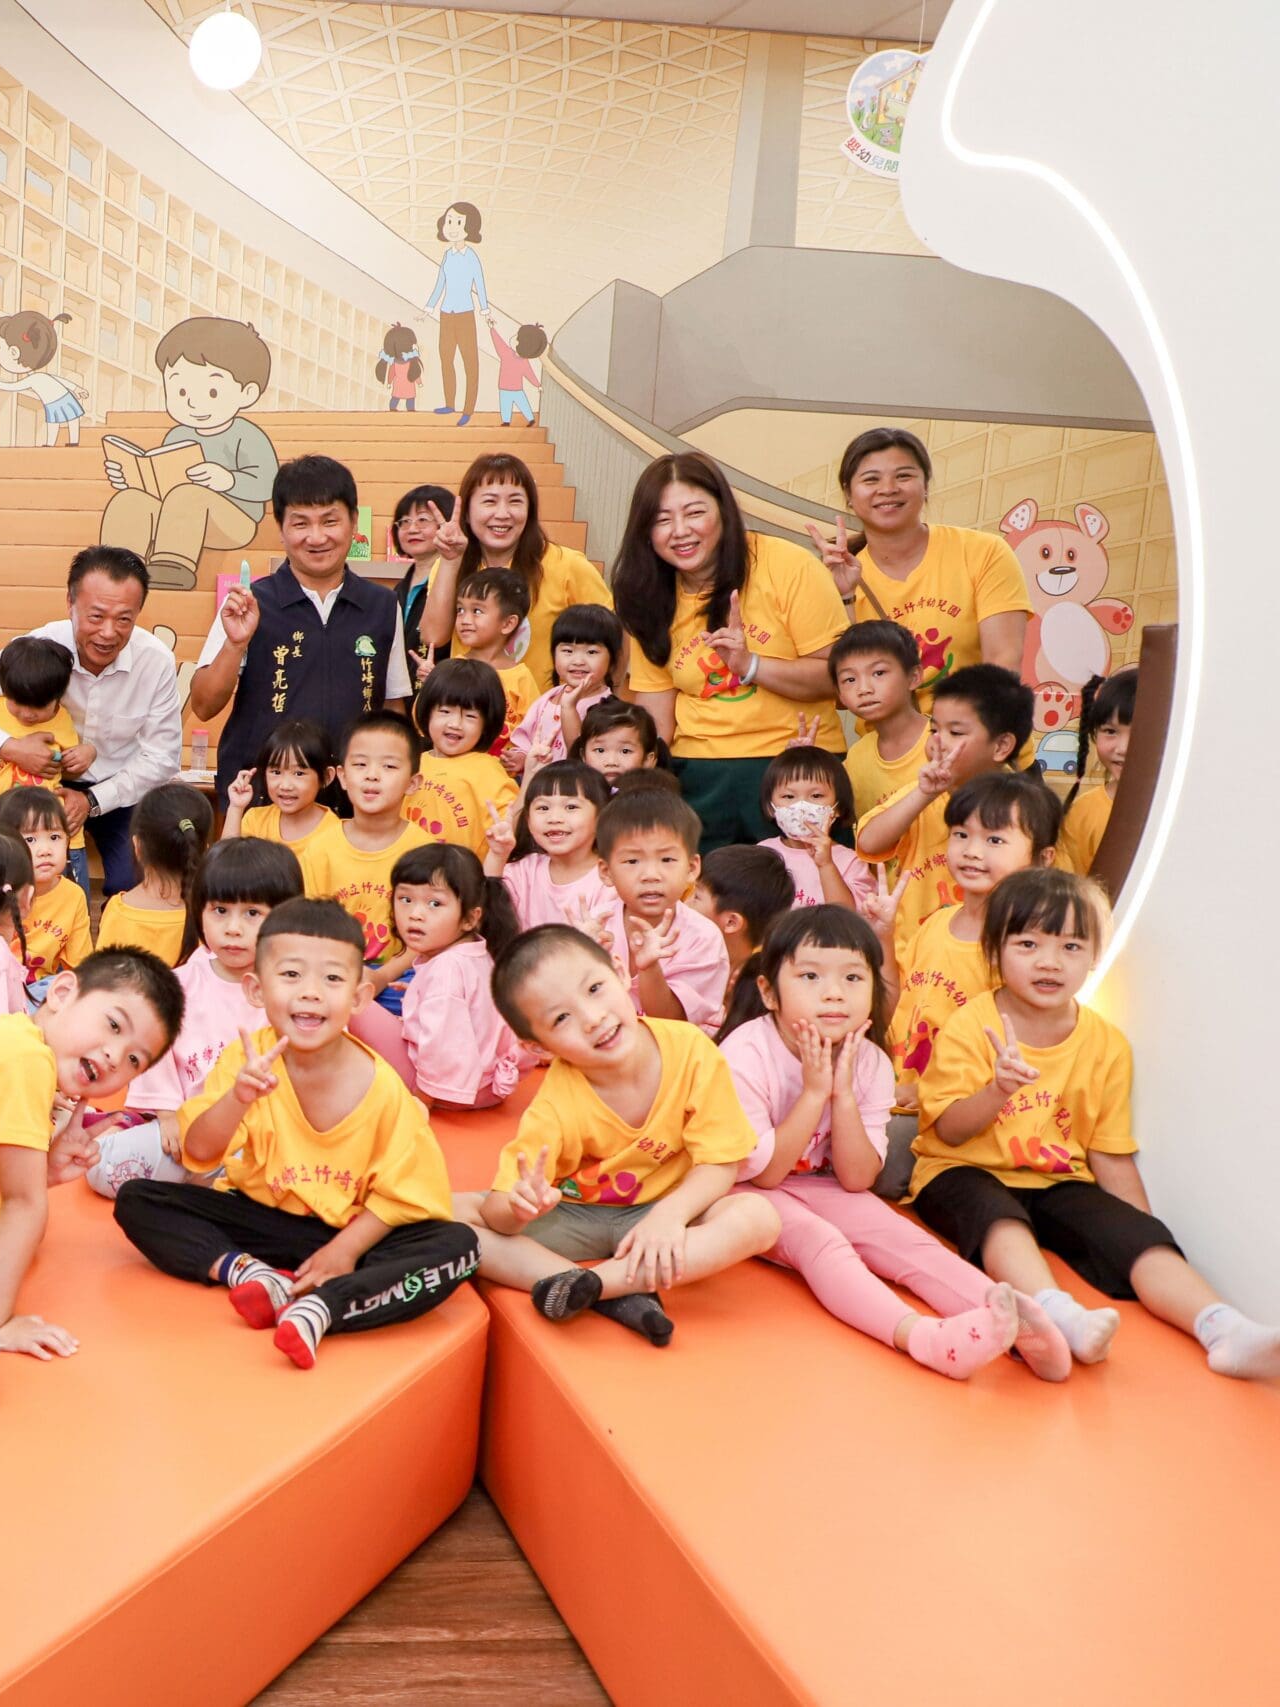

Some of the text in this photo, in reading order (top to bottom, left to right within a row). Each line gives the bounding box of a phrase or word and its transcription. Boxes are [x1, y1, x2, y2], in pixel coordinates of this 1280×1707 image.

[271, 645, 290, 713] 曾亮哲
[419, 779, 470, 828] 竹崎幼兒園
[423, 1240, 482, 1290] TYLE
